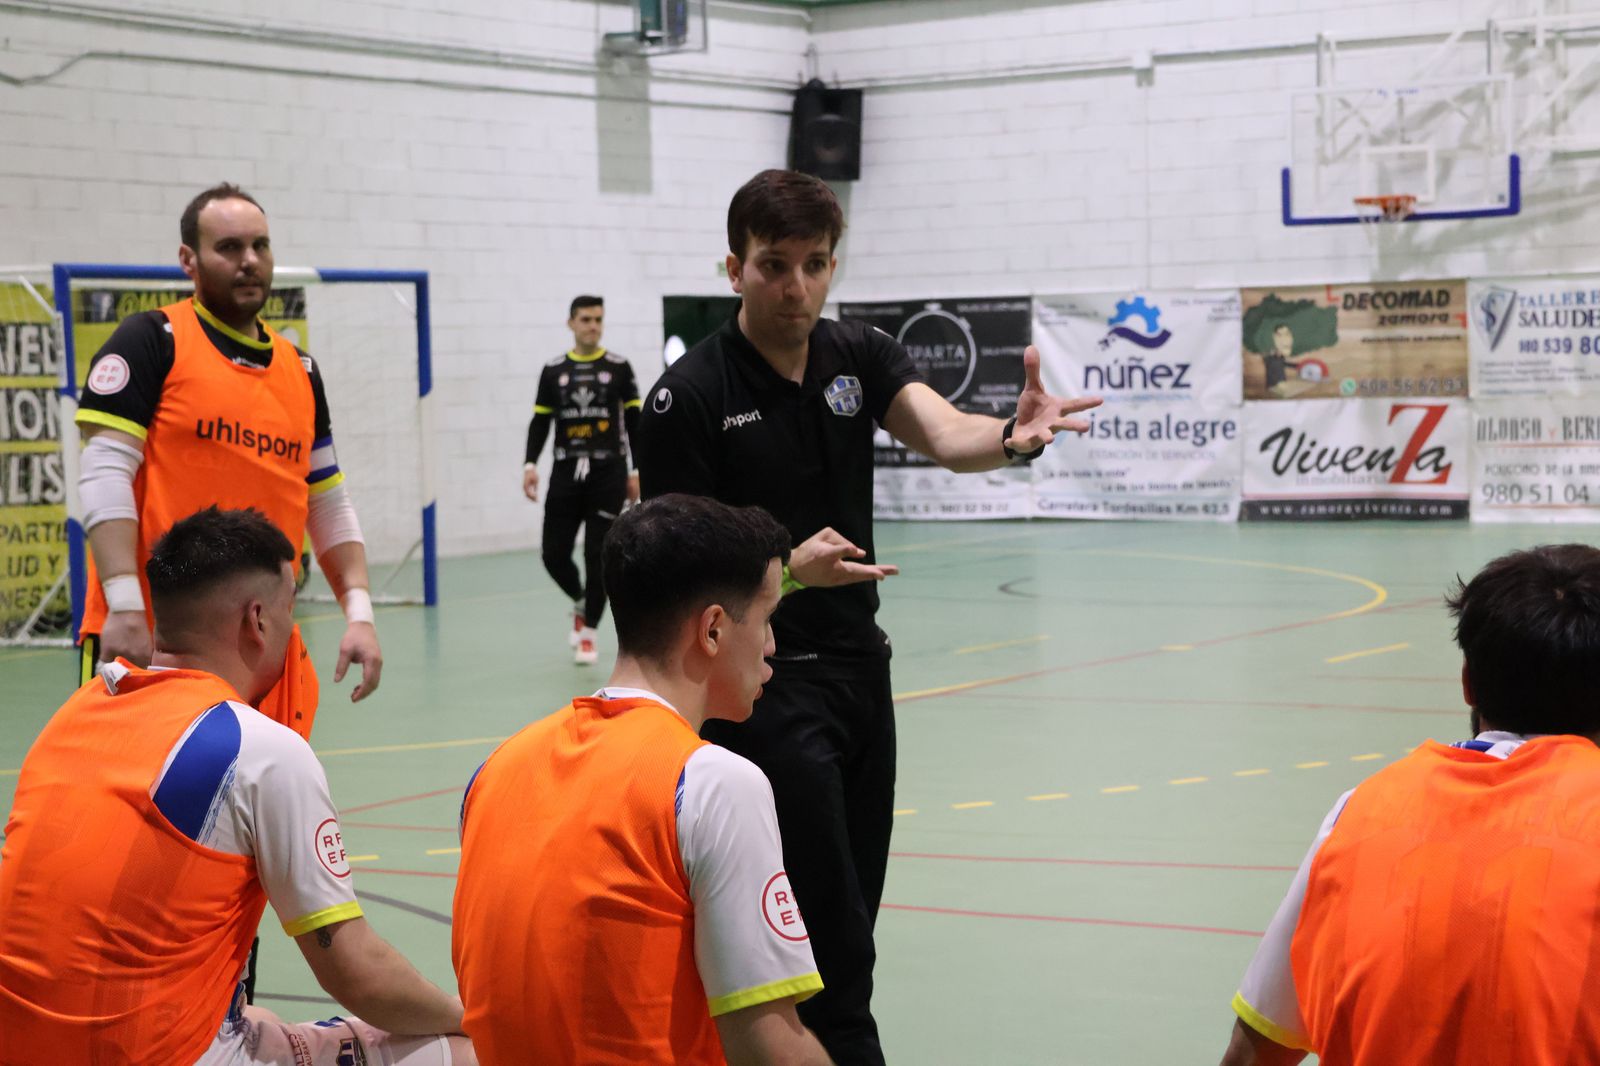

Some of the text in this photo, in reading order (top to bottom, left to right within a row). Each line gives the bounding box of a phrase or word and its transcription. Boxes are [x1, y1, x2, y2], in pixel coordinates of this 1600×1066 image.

[1343, 289, 1450, 311] DECOMAD
[1377, 312, 1449, 327] zamora
[1544, 336, 1572, 354] 539
[1084, 356, 1191, 389] núñez
[722, 409, 762, 431] uhsport
[1148, 413, 1236, 447] alegre
[196, 417, 302, 463] uhlsport
[0, 455, 65, 503] LIS
[1482, 483, 1590, 504] 980 51 04
